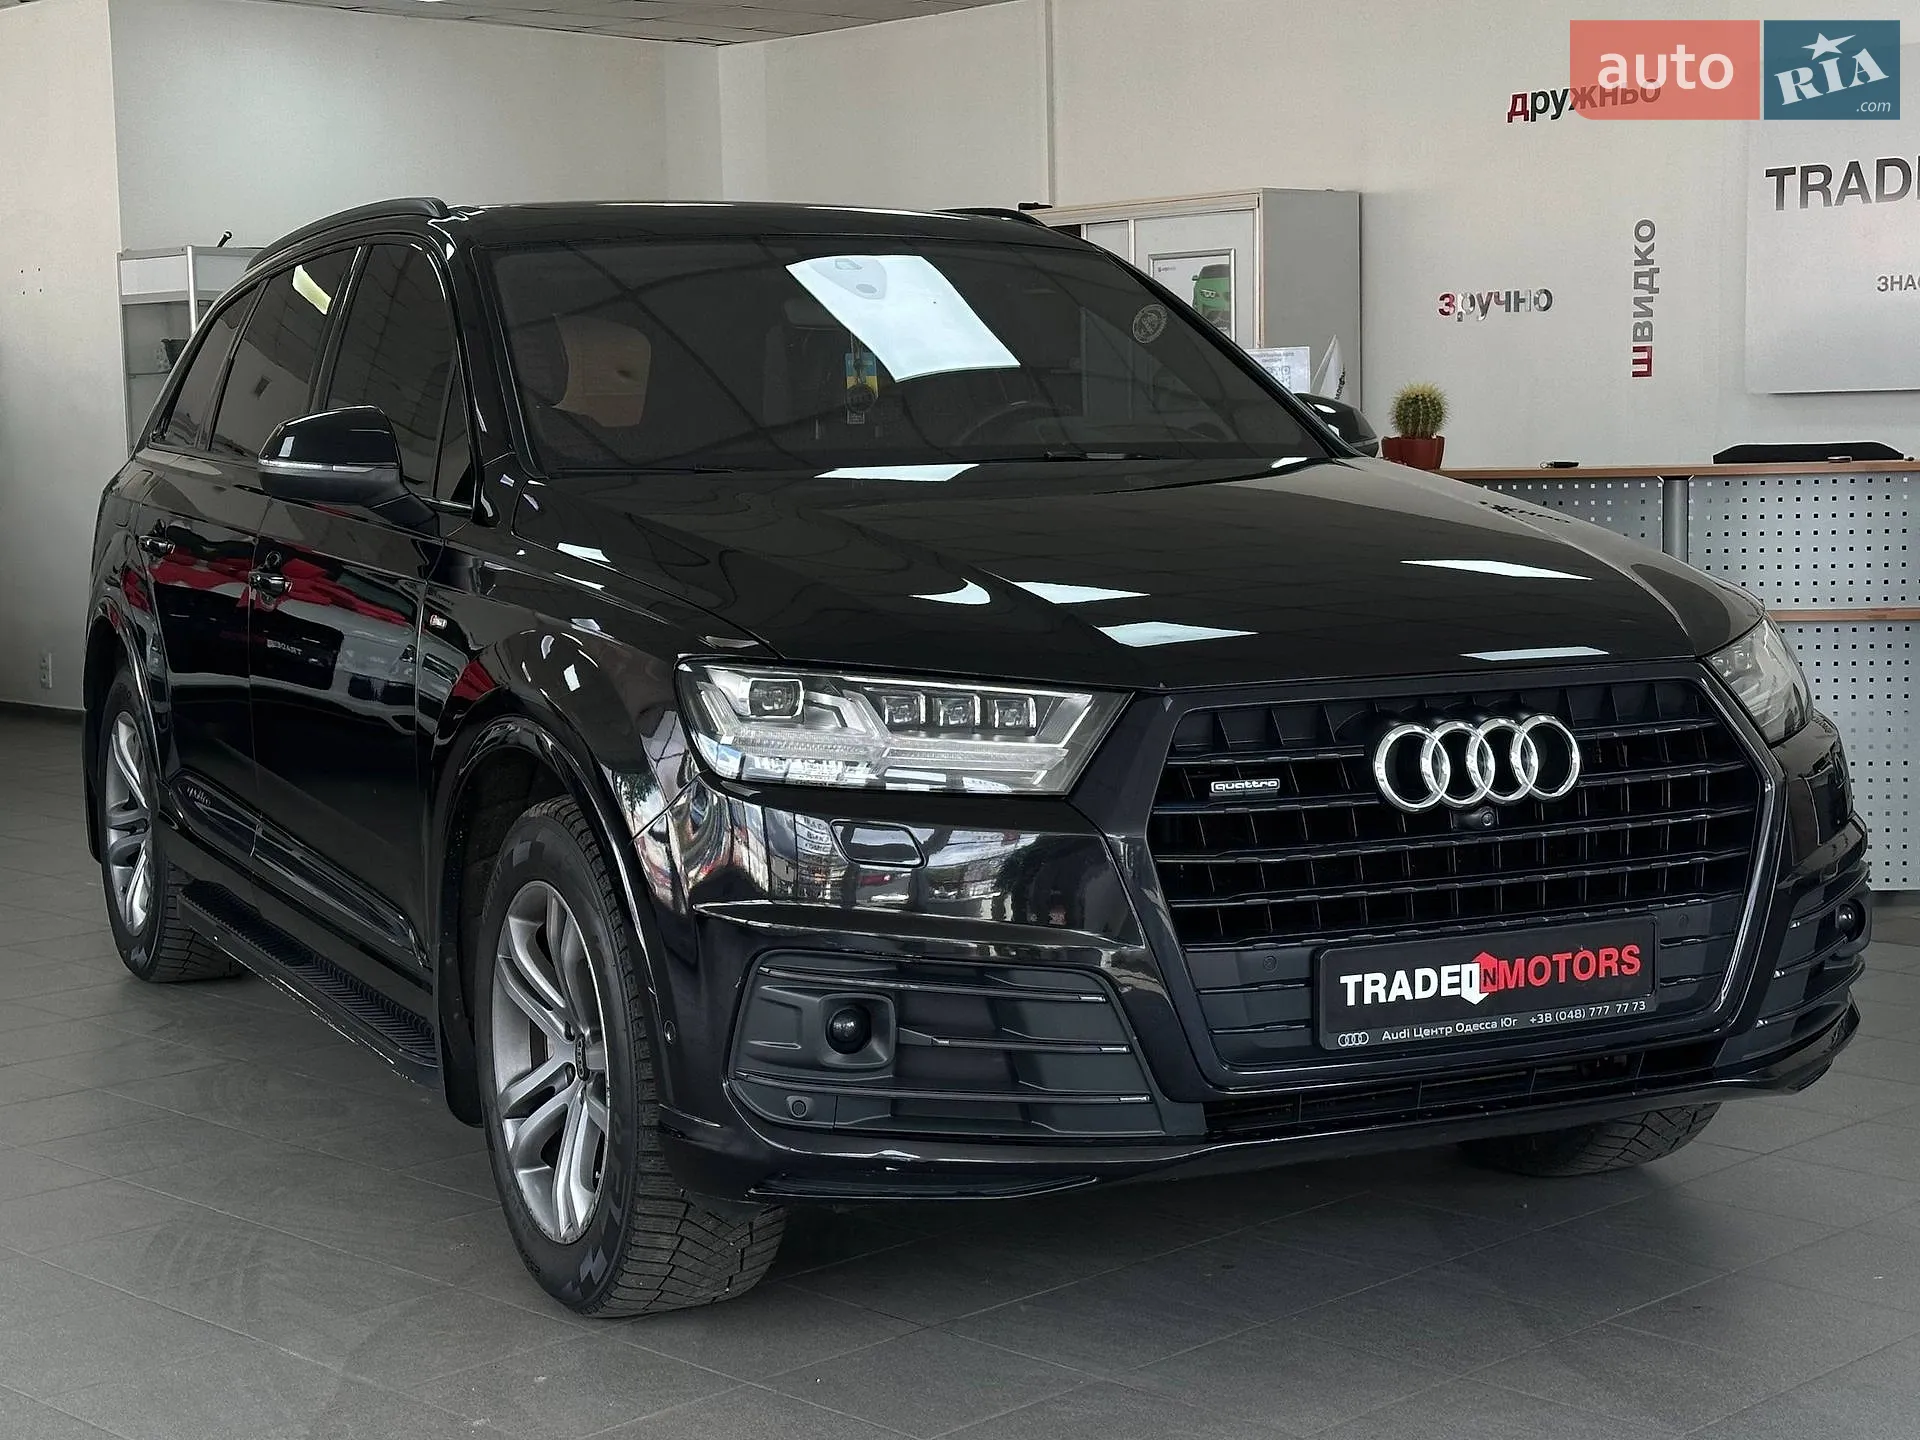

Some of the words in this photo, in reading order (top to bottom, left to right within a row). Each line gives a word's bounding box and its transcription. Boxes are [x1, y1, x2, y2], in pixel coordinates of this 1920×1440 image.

[1507, 79, 1661, 123] дружньо
[1765, 156, 1920, 211] TRAD
[1877, 274, 1920, 292] ЗНА
[1438, 288, 1553, 322] зручно
[1213, 779, 1279, 792] quattro
[1382, 1028, 1410, 1041] Audi
[1413, 1025, 1452, 1039] Центр
[1455, 1021, 1497, 1034] Одесса
[1501, 1017, 1518, 1029] Юг
[1530, 1012, 1552, 1025] +38
[1555, 1008, 1586, 1022] (048)
[1589, 1005, 1610, 1018] 777
